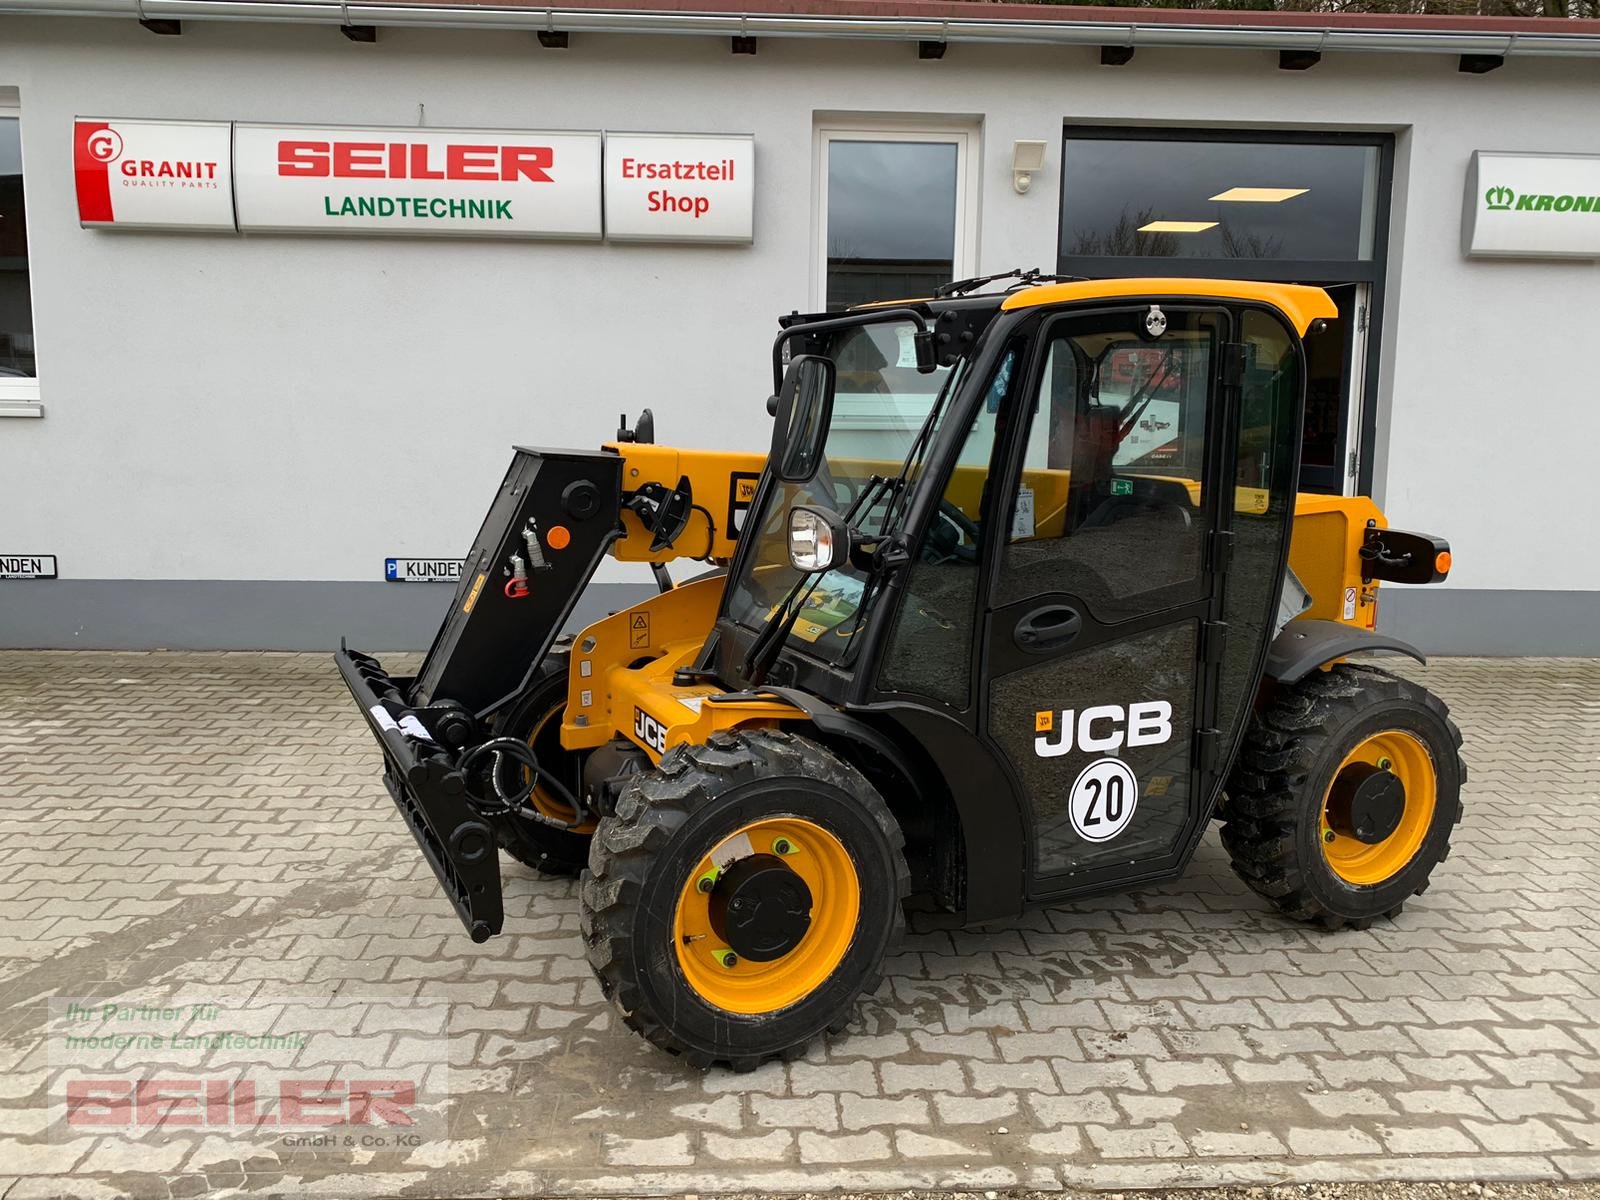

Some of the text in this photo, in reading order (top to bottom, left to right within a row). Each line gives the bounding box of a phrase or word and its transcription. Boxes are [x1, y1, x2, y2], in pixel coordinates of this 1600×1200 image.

[89, 136, 114, 160] G
[121, 159, 218, 179] GRANIT
[277, 140, 555, 182] SEILER
[622, 158, 735, 181] Ersatzteil
[122, 179, 218, 189] QUALITY PARTS
[324, 196, 514, 220] LANDTECHNIK
[647, 189, 710, 219] Shop
[387, 563, 397, 575] P
[635, 711, 668, 755] JCB
[1034, 700, 1173, 758] JCB
[1083, 774, 1124, 827] 20
